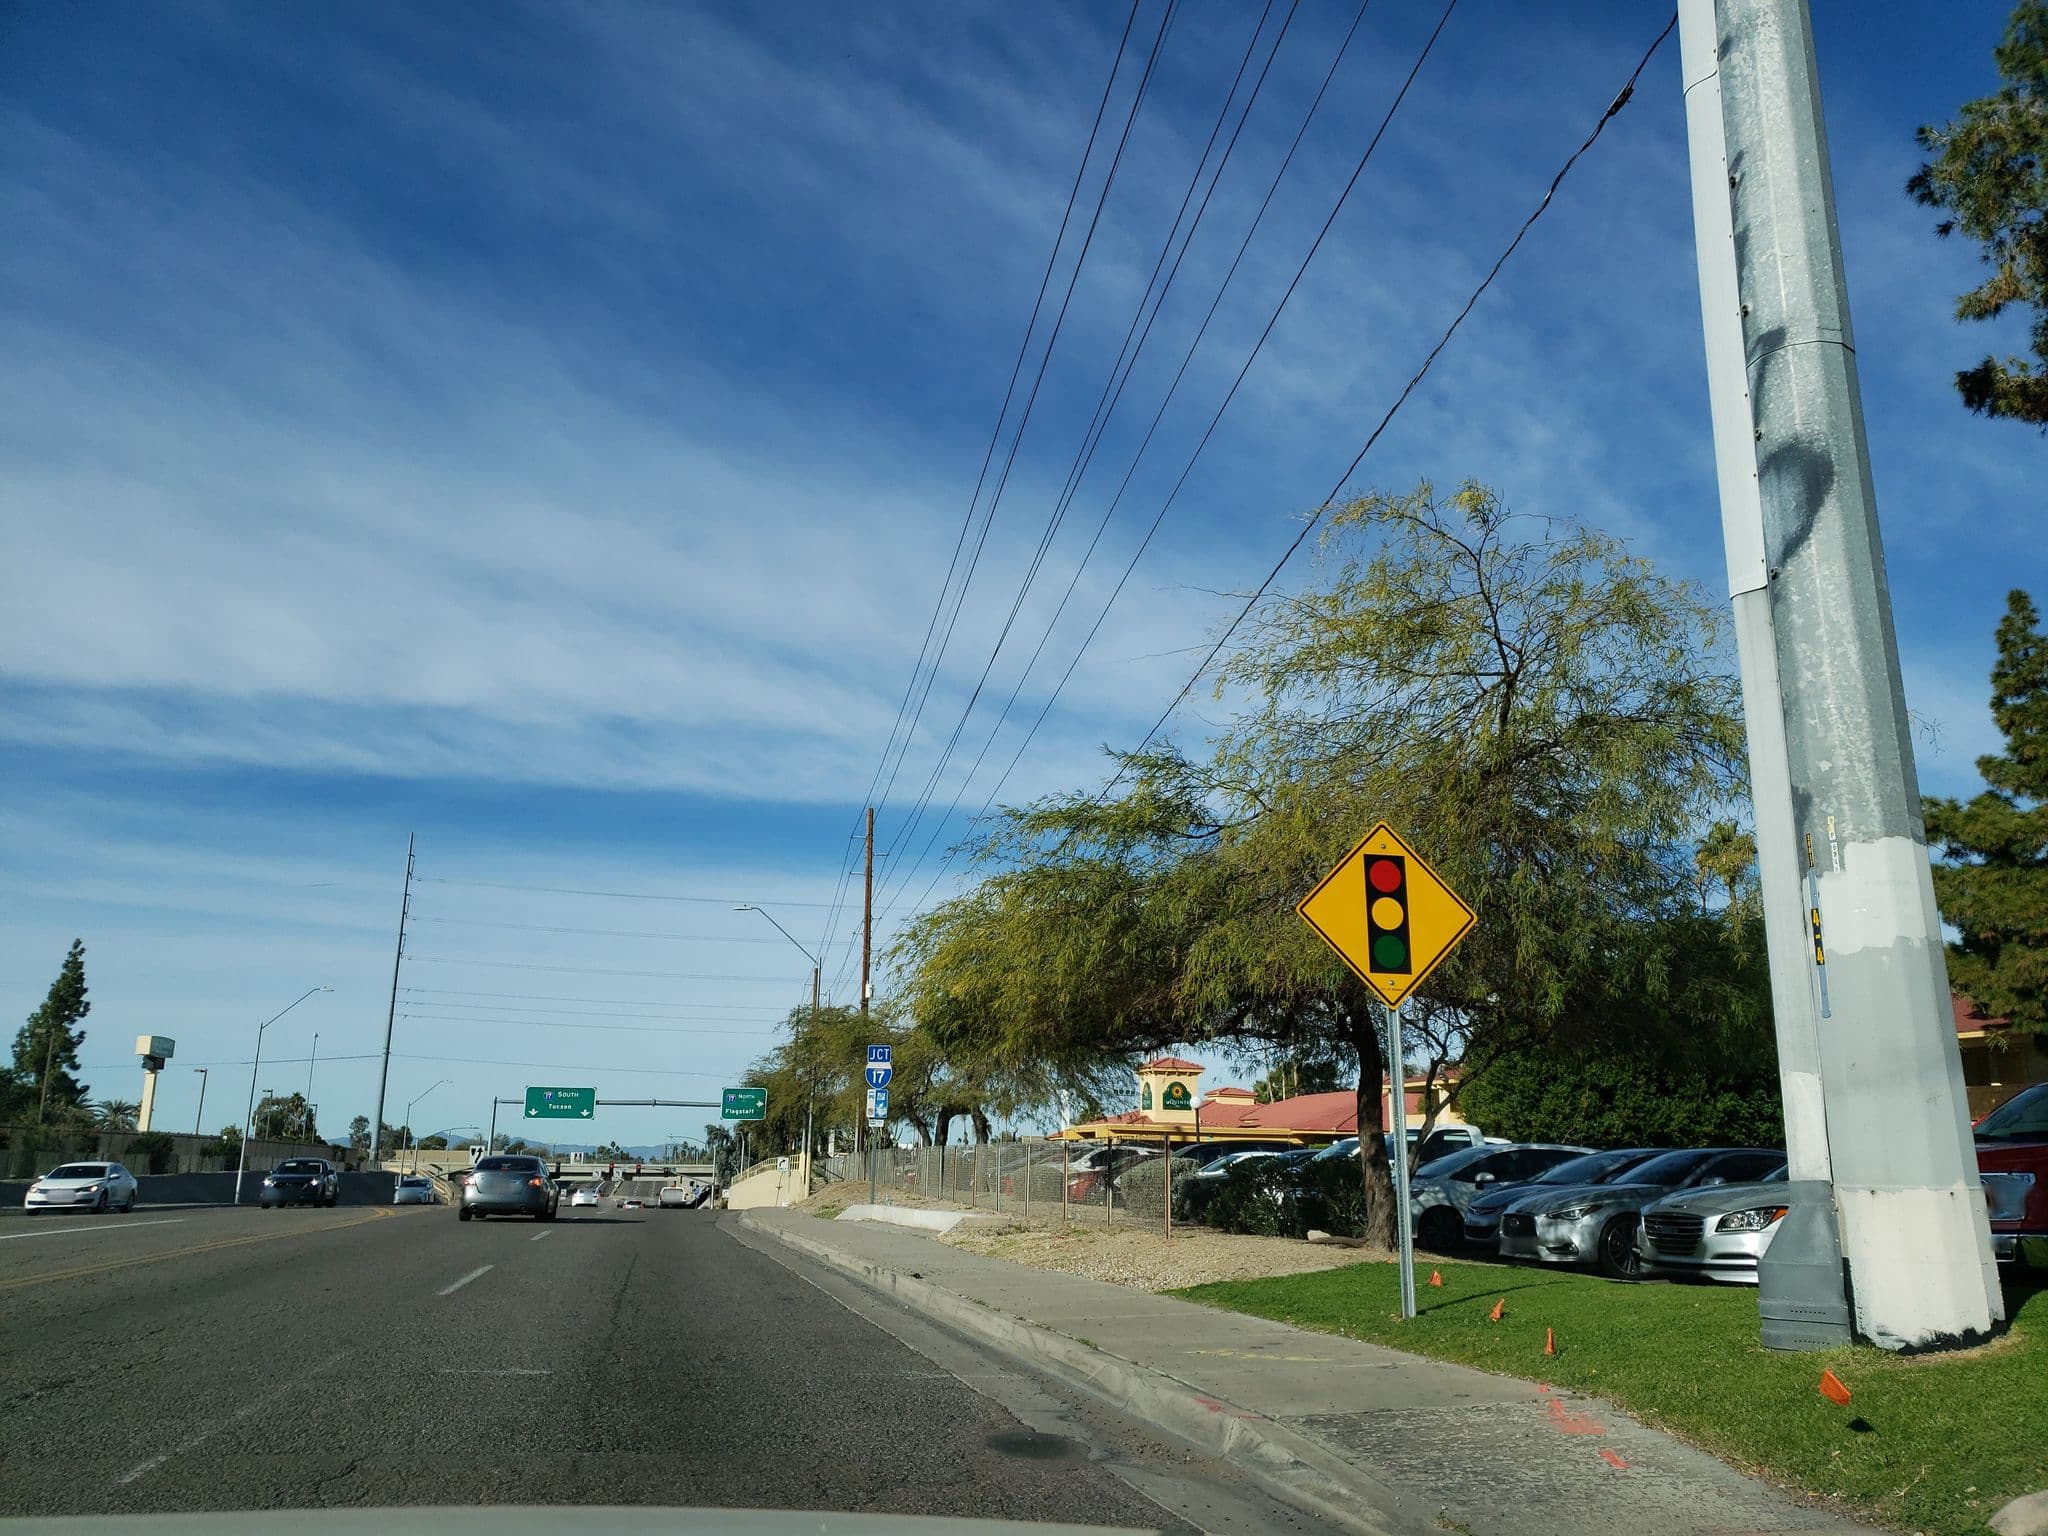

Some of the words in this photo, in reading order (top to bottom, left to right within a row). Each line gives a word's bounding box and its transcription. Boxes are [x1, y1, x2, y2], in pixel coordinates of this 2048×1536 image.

[869, 1048, 890, 1060] JCT
[872, 1070, 885, 1084] 17
[725, 1108, 754, 1116] Flagstaff
